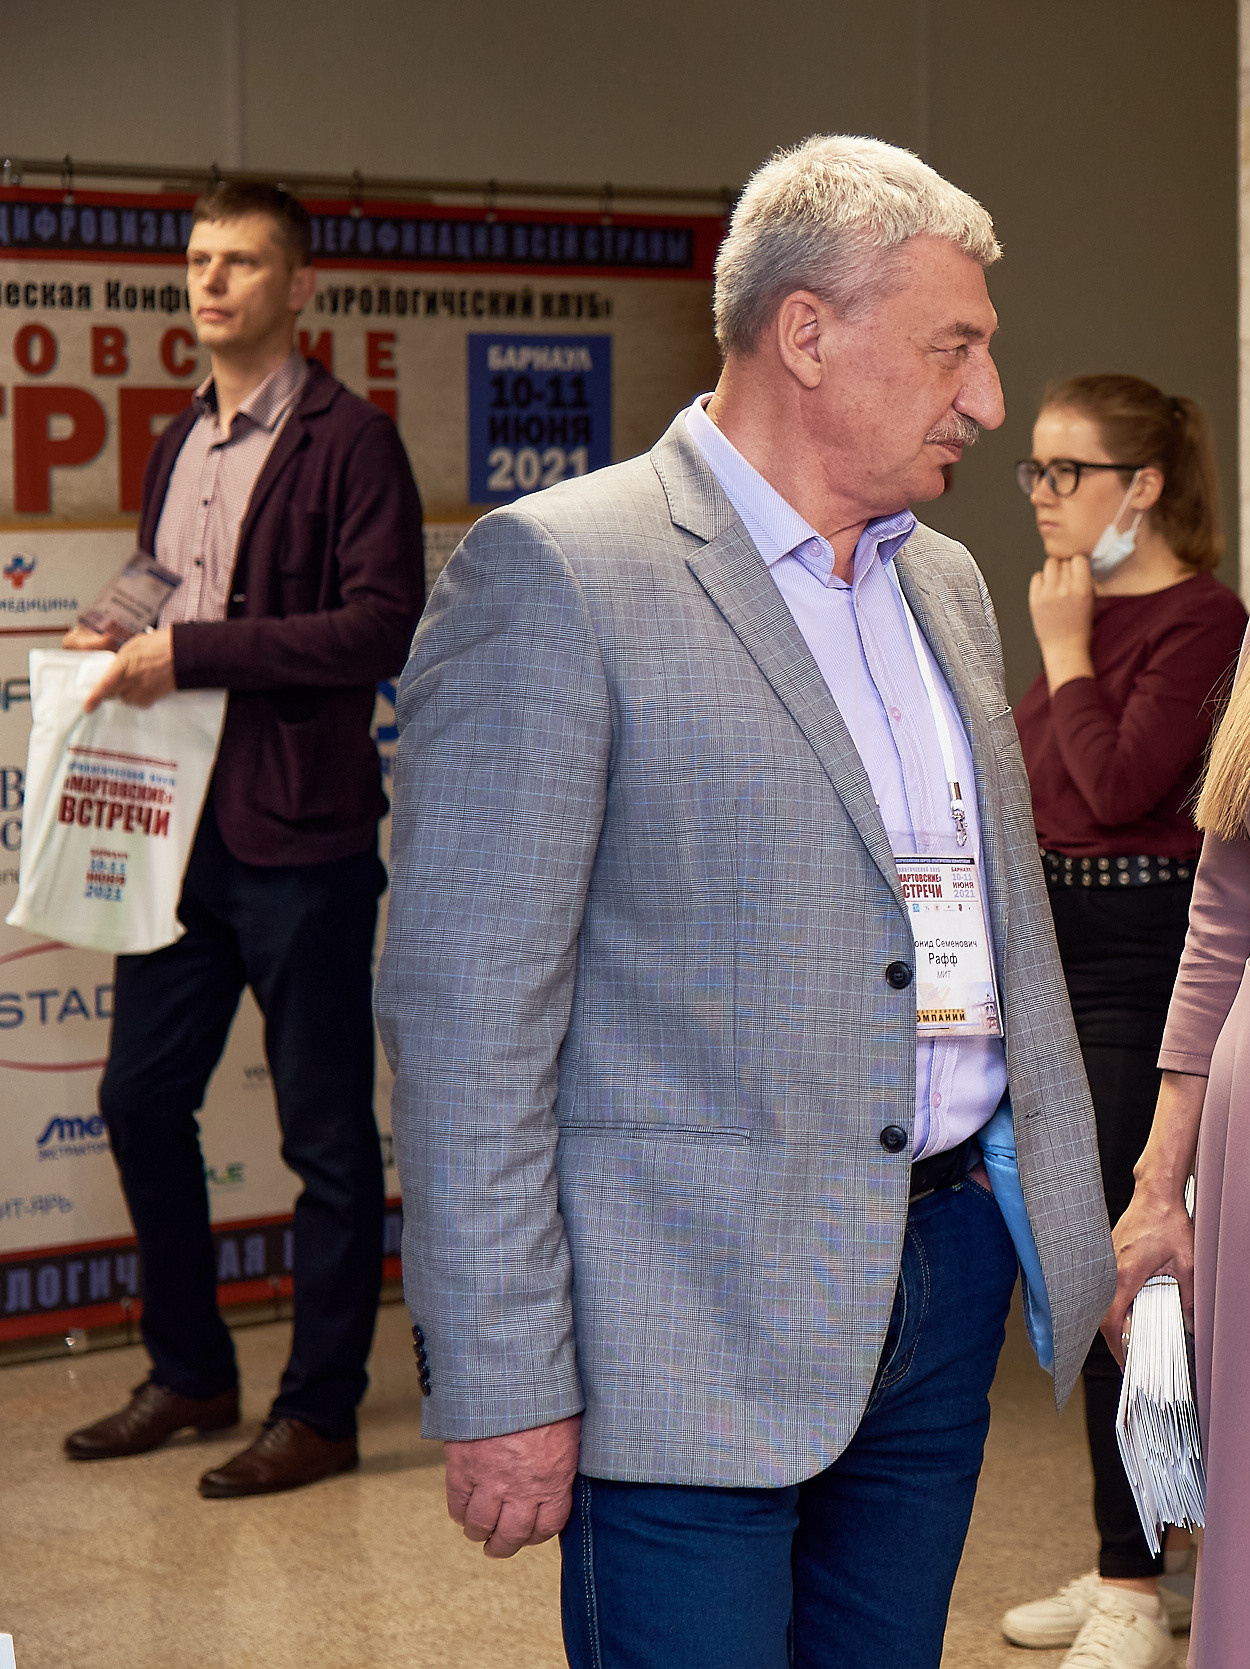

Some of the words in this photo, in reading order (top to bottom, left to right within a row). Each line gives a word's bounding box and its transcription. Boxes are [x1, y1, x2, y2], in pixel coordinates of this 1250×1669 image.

[0, 281, 91, 309] еская
[106, 278, 190, 314] Конф
[488, 345, 592, 373] БАРНАУЛ
[490, 374, 590, 409] 10-11
[489, 416, 592, 445] ИЮНЯ
[487, 446, 588, 491] 2021
[58, 795, 170, 838] ВСТРЕЧИ
[903, 884, 943, 899] СТРЕЧИ
[954, 889, 975, 898] 2021
[935, 938, 978, 948] Семенович
[928, 952, 958, 968] Рафф
[936, 970, 951, 979] МИТ
